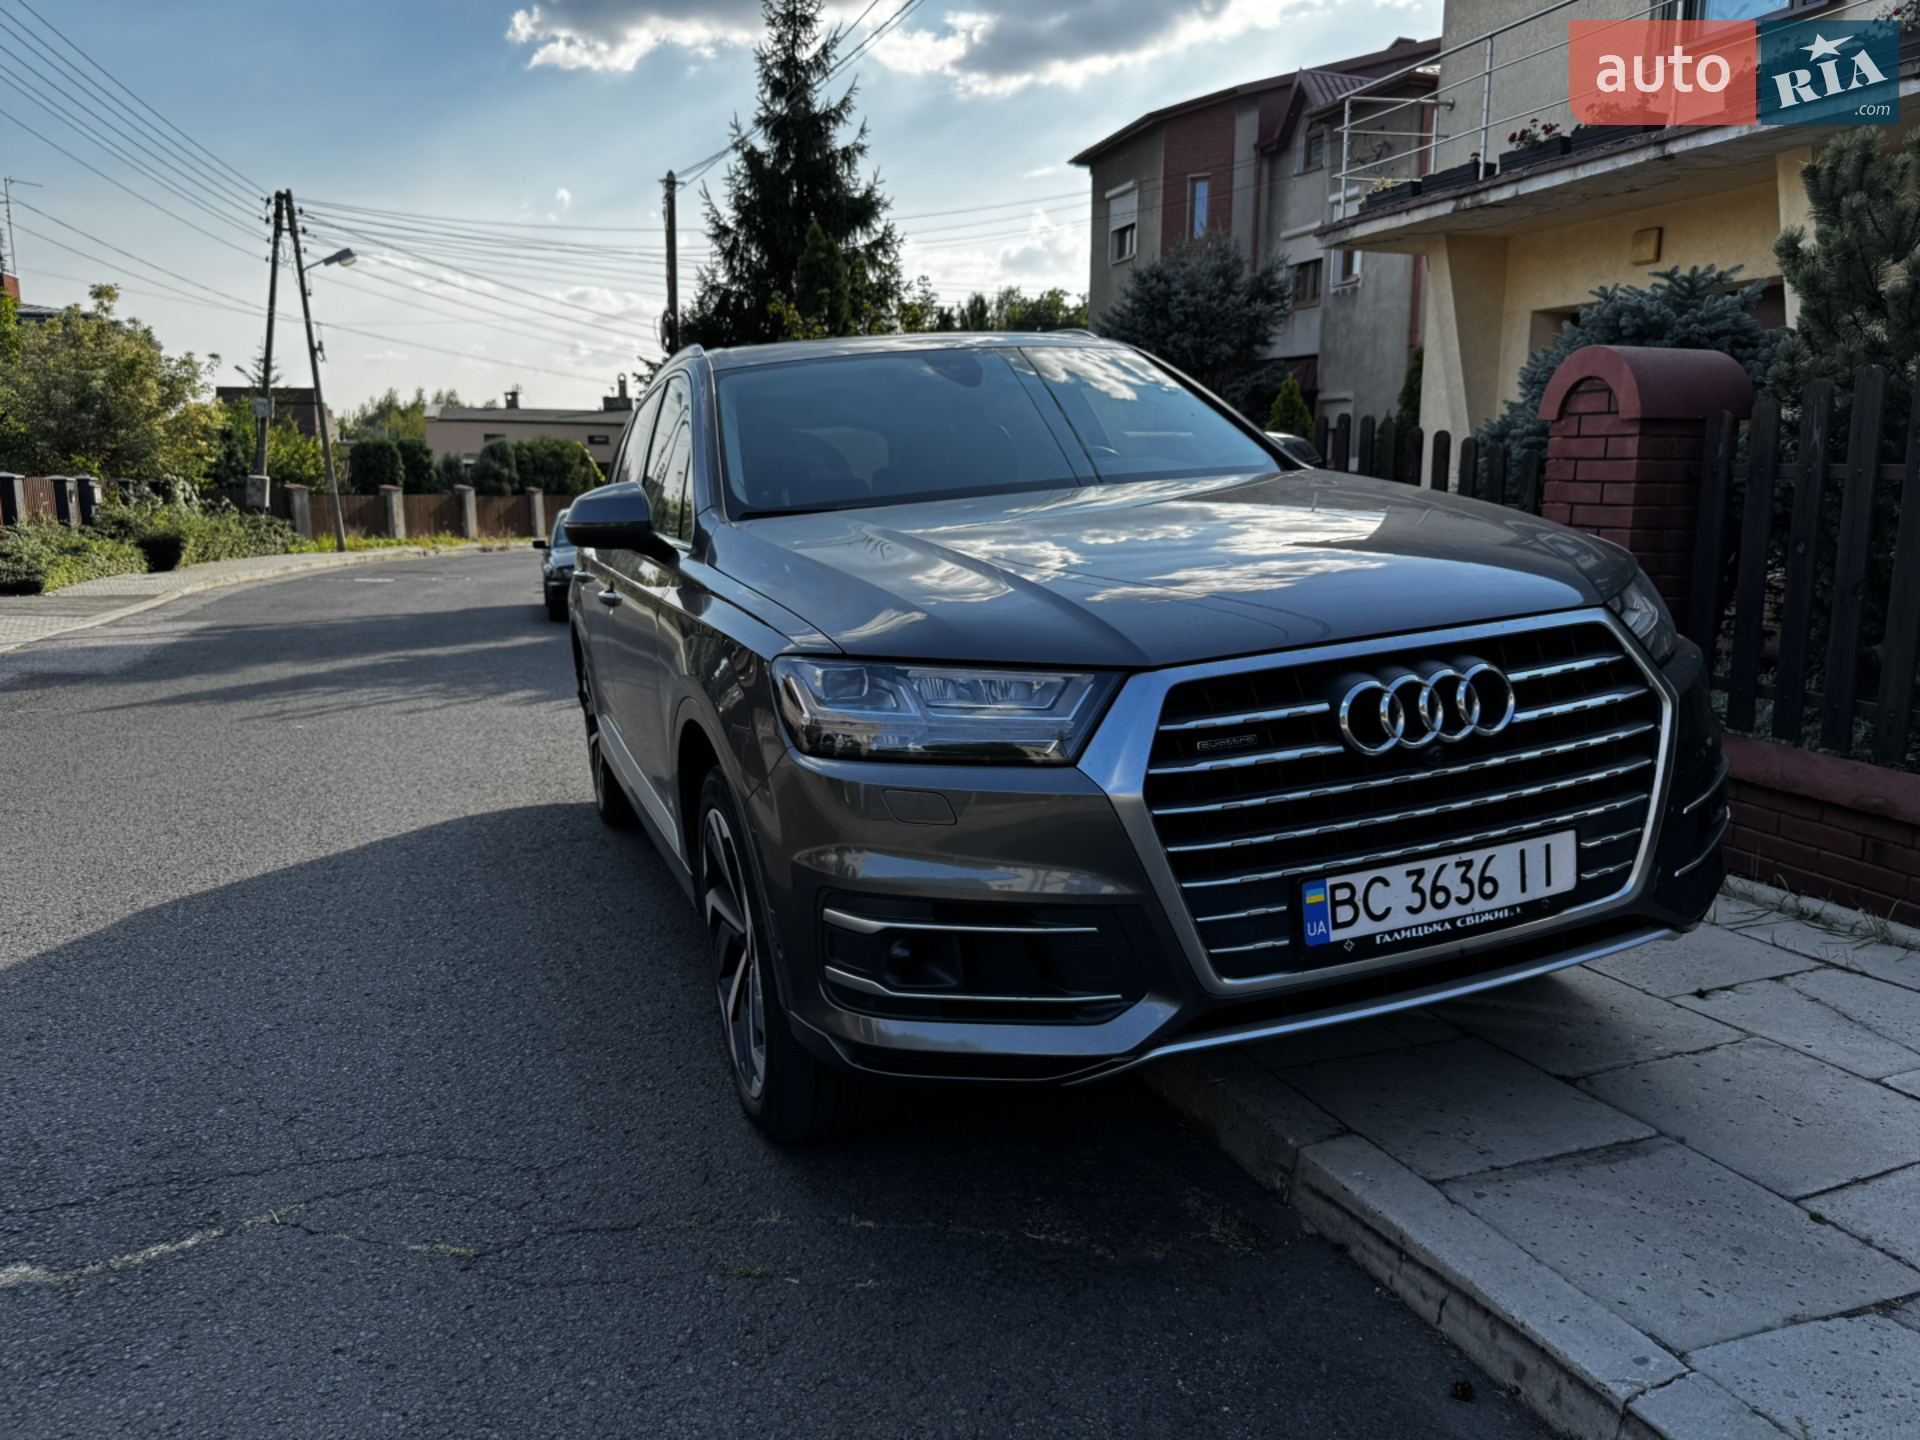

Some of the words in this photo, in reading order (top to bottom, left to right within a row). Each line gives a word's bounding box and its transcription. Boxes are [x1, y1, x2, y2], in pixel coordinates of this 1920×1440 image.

[1404, 854, 1499, 915] 3636
[1307, 919, 1327, 937] UA
[1375, 922, 1452, 945] ГАЛИЦЬКА
